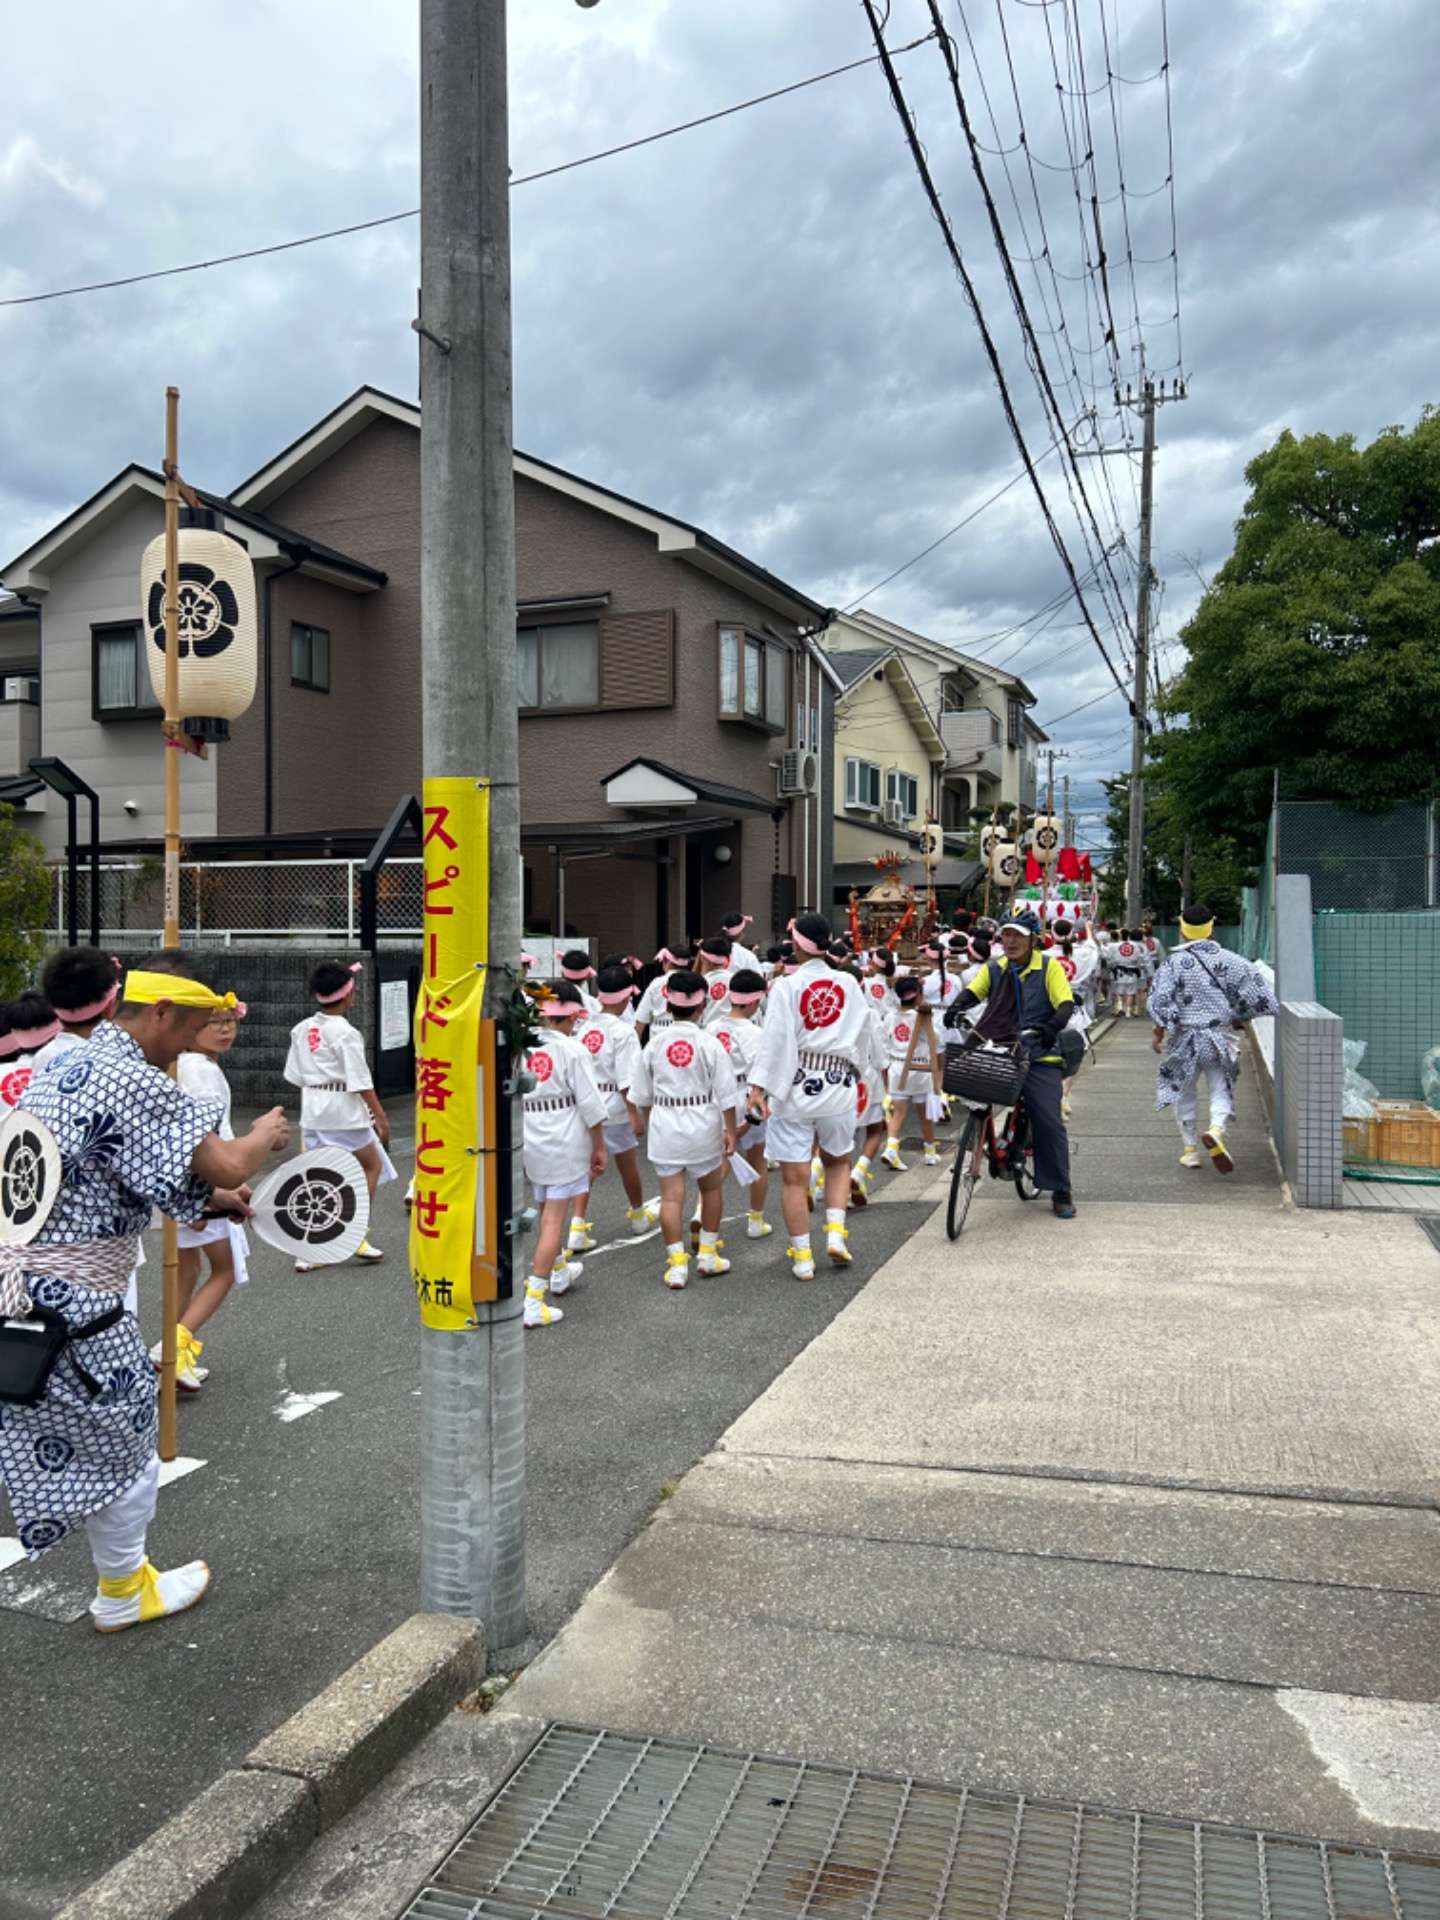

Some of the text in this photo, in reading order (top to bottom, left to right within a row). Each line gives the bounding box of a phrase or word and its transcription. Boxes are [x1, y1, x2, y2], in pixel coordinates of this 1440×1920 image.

[416, 806, 460, 1239] スピード落とせ
[414, 1268, 454, 1307] 木市
